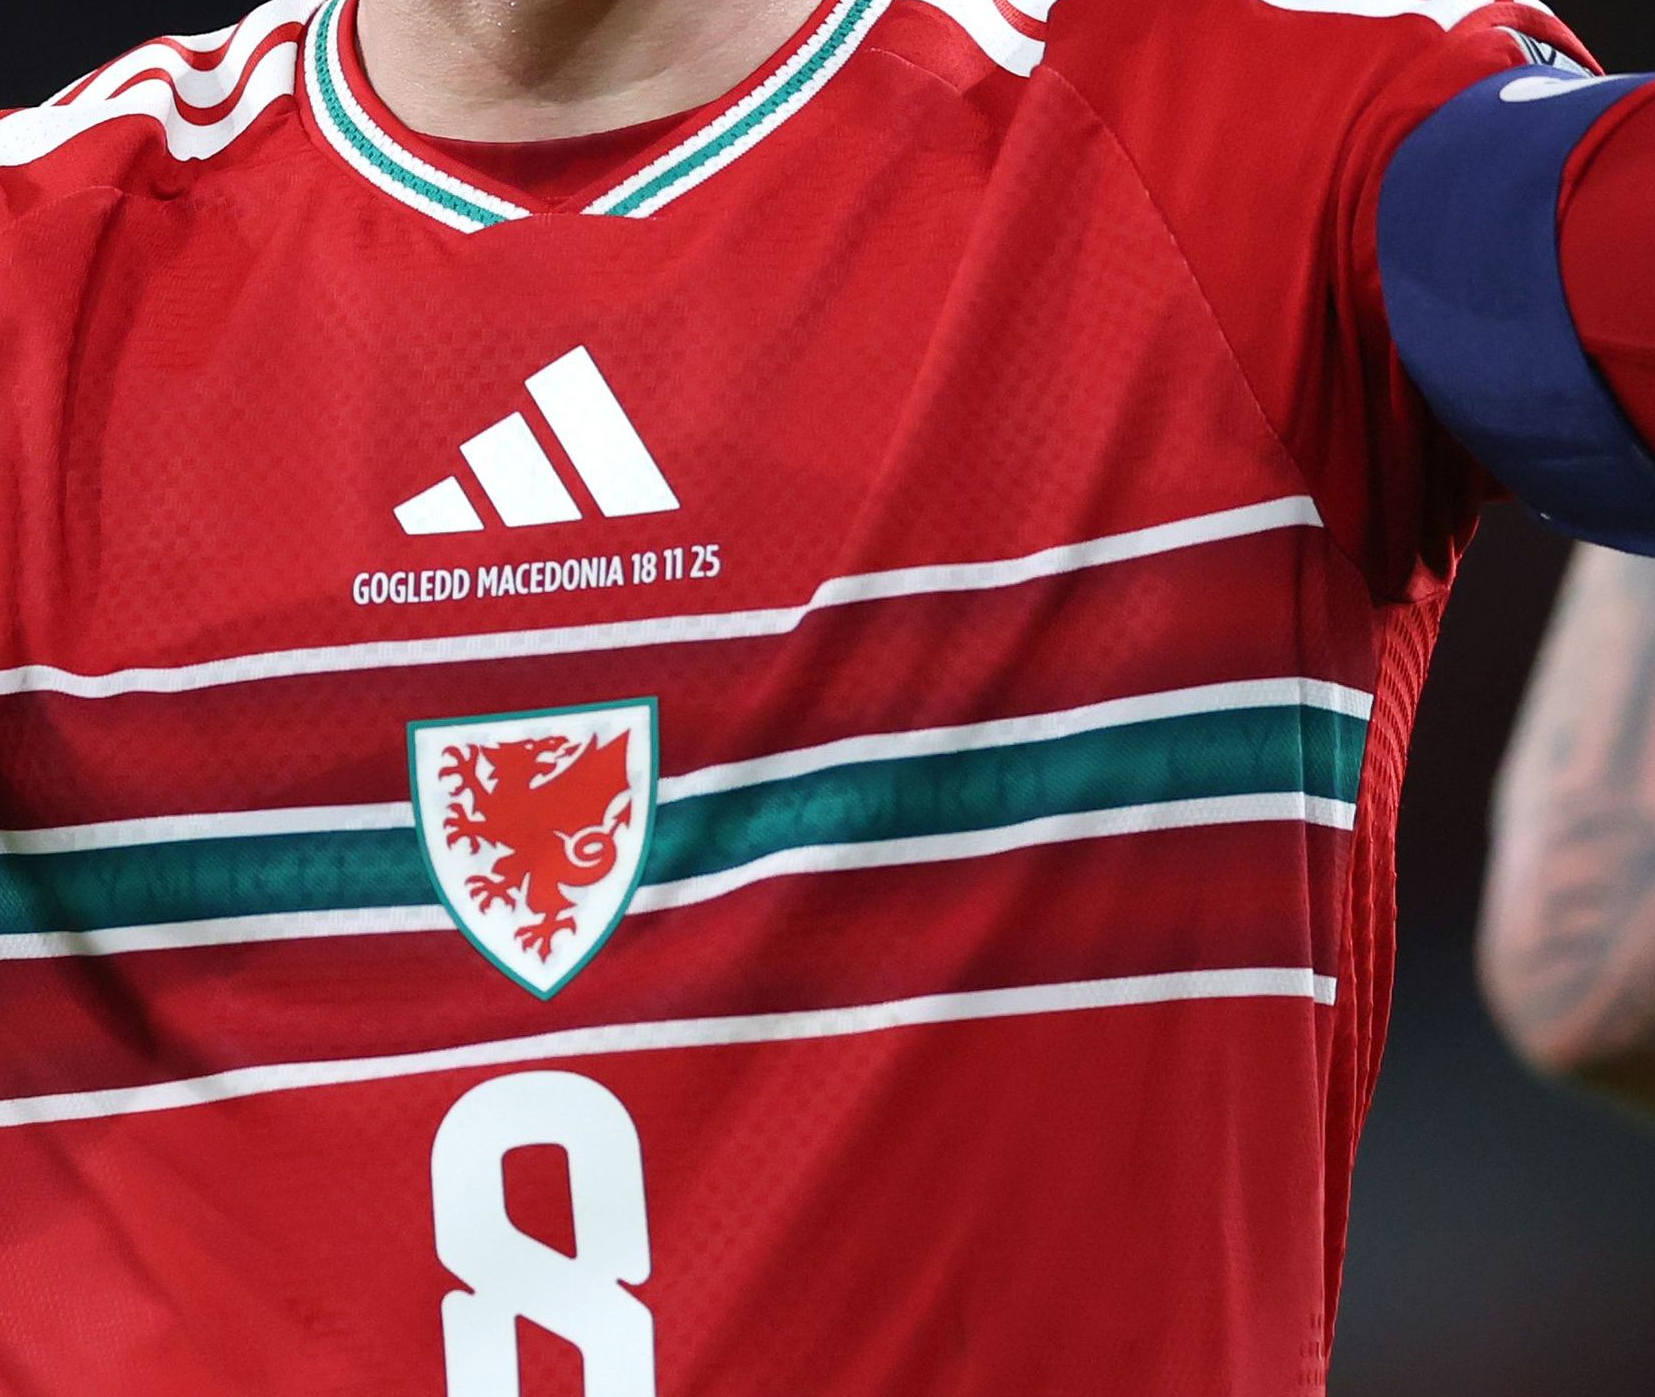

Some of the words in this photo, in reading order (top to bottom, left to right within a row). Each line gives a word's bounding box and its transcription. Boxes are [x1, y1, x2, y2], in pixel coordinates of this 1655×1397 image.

[352, 567, 470, 605] GOGLEDD
[476, 555, 625, 599] MACEDONIA
[631, 551, 658, 585] 18
[663, 547, 684, 581] 11
[689, 544, 721, 579] 25
[430, 1069, 657, 1397] 8
